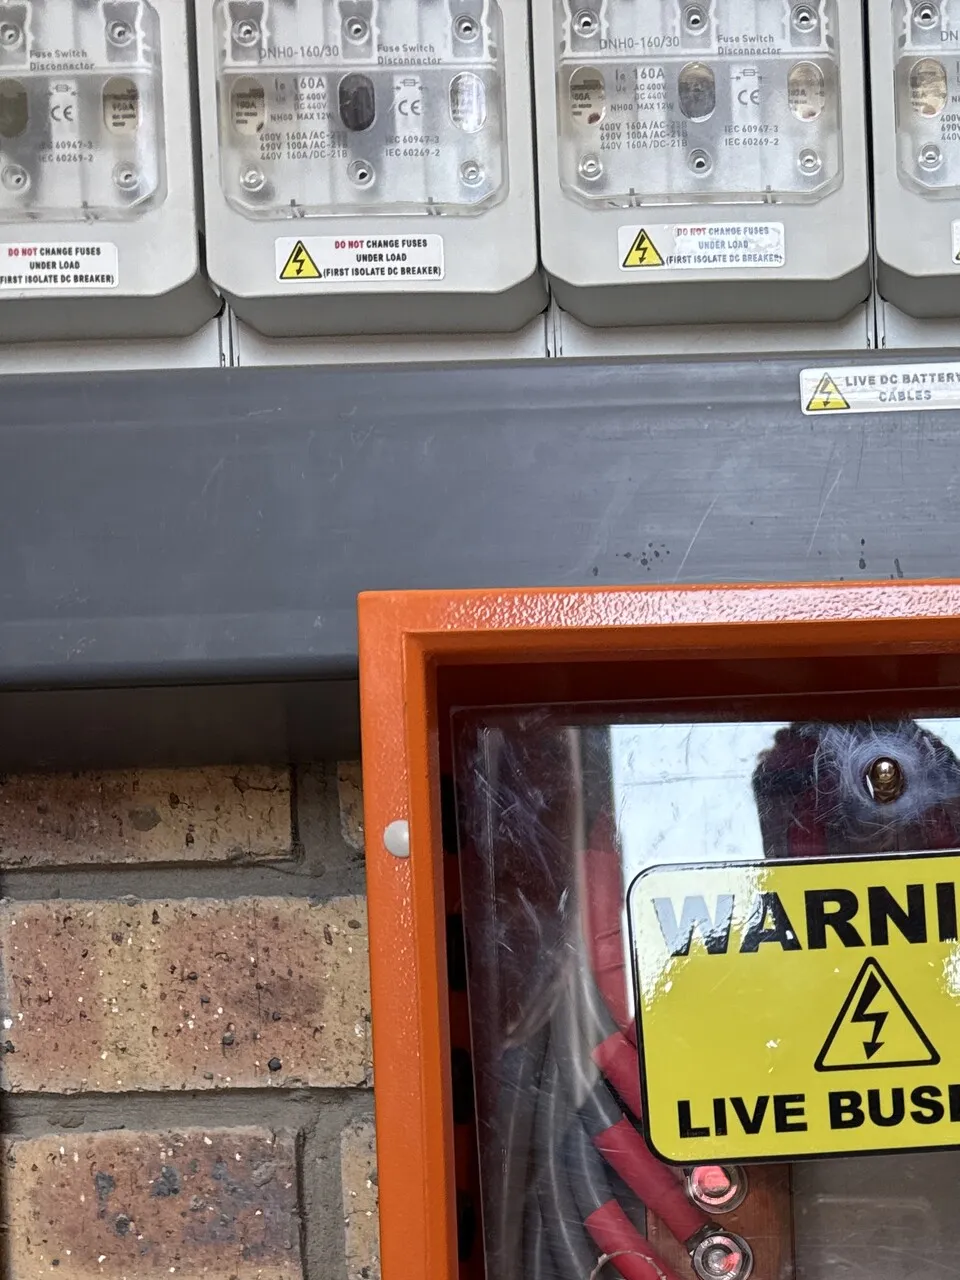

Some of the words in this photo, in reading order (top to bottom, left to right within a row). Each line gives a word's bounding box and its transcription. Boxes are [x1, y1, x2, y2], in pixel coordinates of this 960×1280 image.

[600, 37, 679, 49] DNH0-160/30
[30, 50, 52, 58] Fuse
[55, 50, 87, 58] Switch
[260, 47, 339, 59] DNH0-160/30
[718, 47, 781, 55] Disconnector
[378, 57, 442, 65] Disconnector
[30, 62, 94, 71] Disconnector
[634, 69, 664, 78] 160A
[294, 78, 324, 89] 160A
[51, 106, 74, 121] CE
[403, 136, 439, 144] 60947-3
[56, 141, 93, 149] 60947-3
[386, 149, 400, 157] IEC
[56, 154, 93, 162] 60269-2
[677, 228, 688, 236] DO
[709, 227, 741, 235] CHANGE
[744, 227, 769, 235] FUSES
[366, 240, 399, 248] CHANGE
[402, 239, 427, 247] FUSES
[699, 241, 725, 249] UNDER
[728, 240, 748, 248] LOAD
[8, 248, 19, 256] DO
[22, 248, 37, 256] NOT
[75, 247, 101, 255] FUSES
[356, 254, 383, 262] UNDER
[666, 256, 691, 265] (FIRST
[694, 255, 727, 263] ISOLATE
[30, 261, 56, 269] UNDER
[59, 261, 80, 269] LOAD
[323, 268, 349, 278] (FIRST
[352, 267, 385, 275] ISOLATE
[388, 267, 398, 275] DC
[401, 267, 441, 276] BREAKER)
[25, 275, 58, 283] ISOLATE
[61, 275, 71, 283] DC
[74, 274, 114, 284] BREAKER)
[845, 376, 875, 386] LIVE
[881, 375, 897, 384] DC
[879, 391, 931, 402] CABLES
[678, 1093, 808, 1139] LIVE
